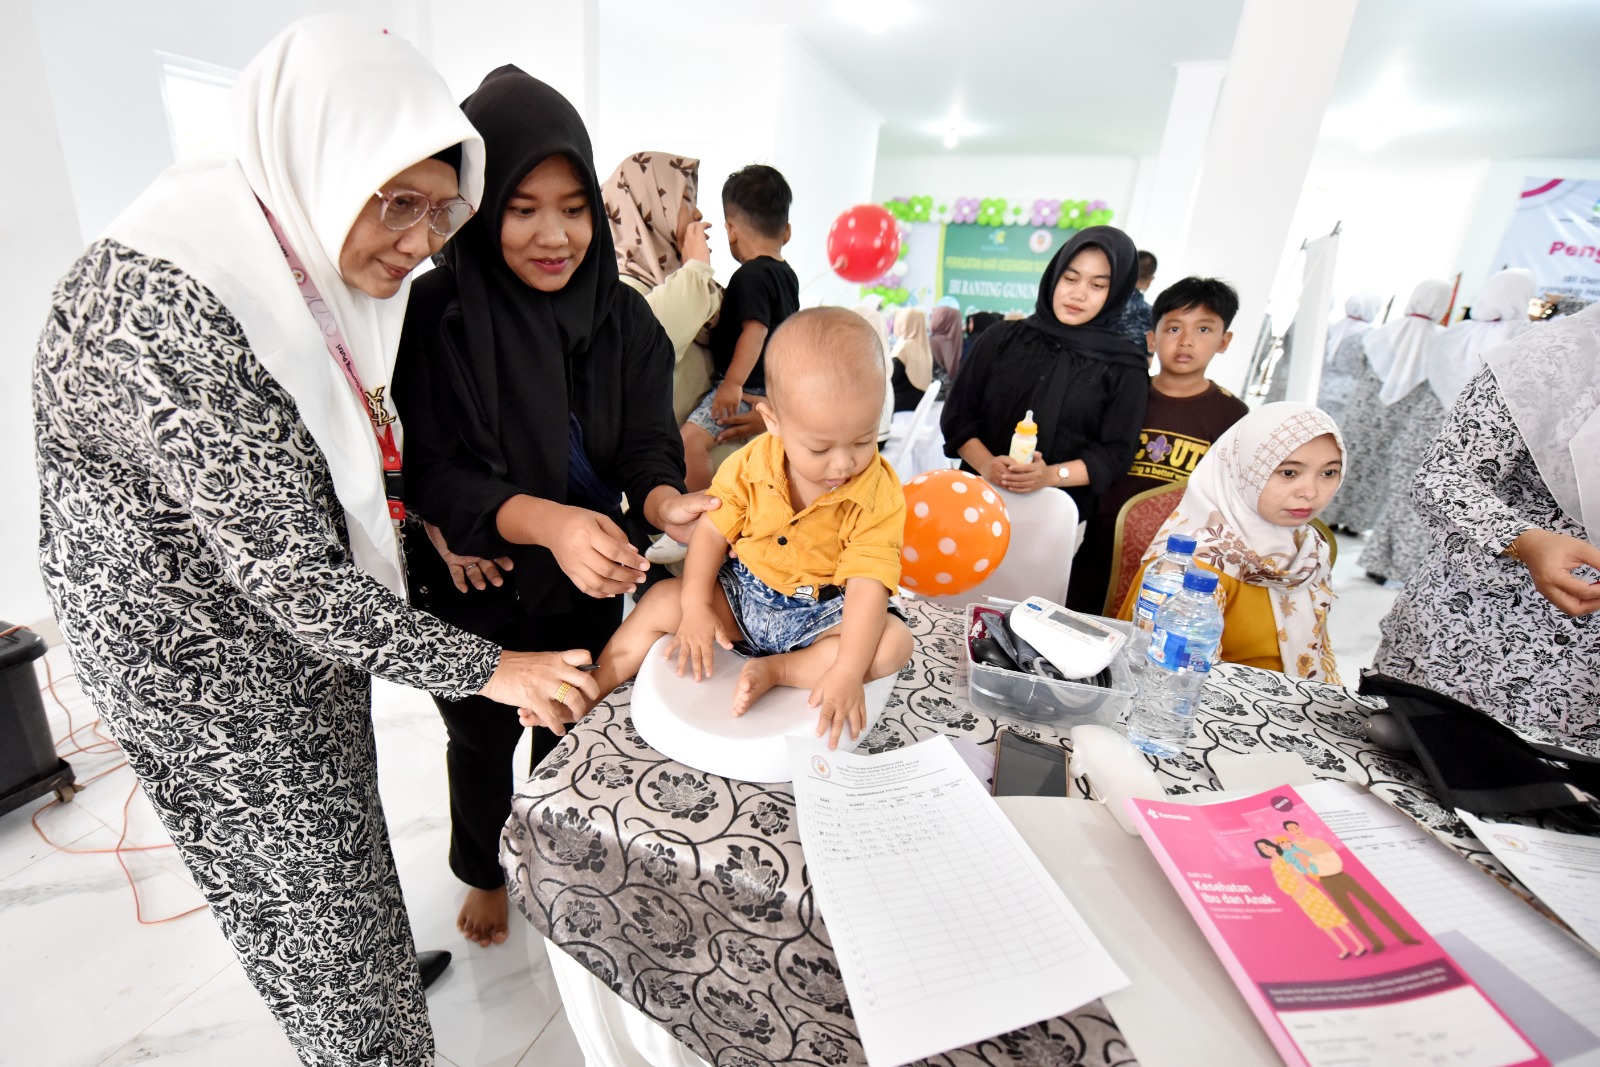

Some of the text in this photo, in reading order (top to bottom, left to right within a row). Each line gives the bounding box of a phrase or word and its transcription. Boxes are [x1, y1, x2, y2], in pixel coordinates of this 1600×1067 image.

[1003, 282, 1040, 299] GUNUN
[336, 344, 348, 363] Putri
[1152, 466, 1175, 478] better
[1192, 880, 1253, 893] Kesehatan
[1200, 892, 1276, 904] Ibu dan Anak
